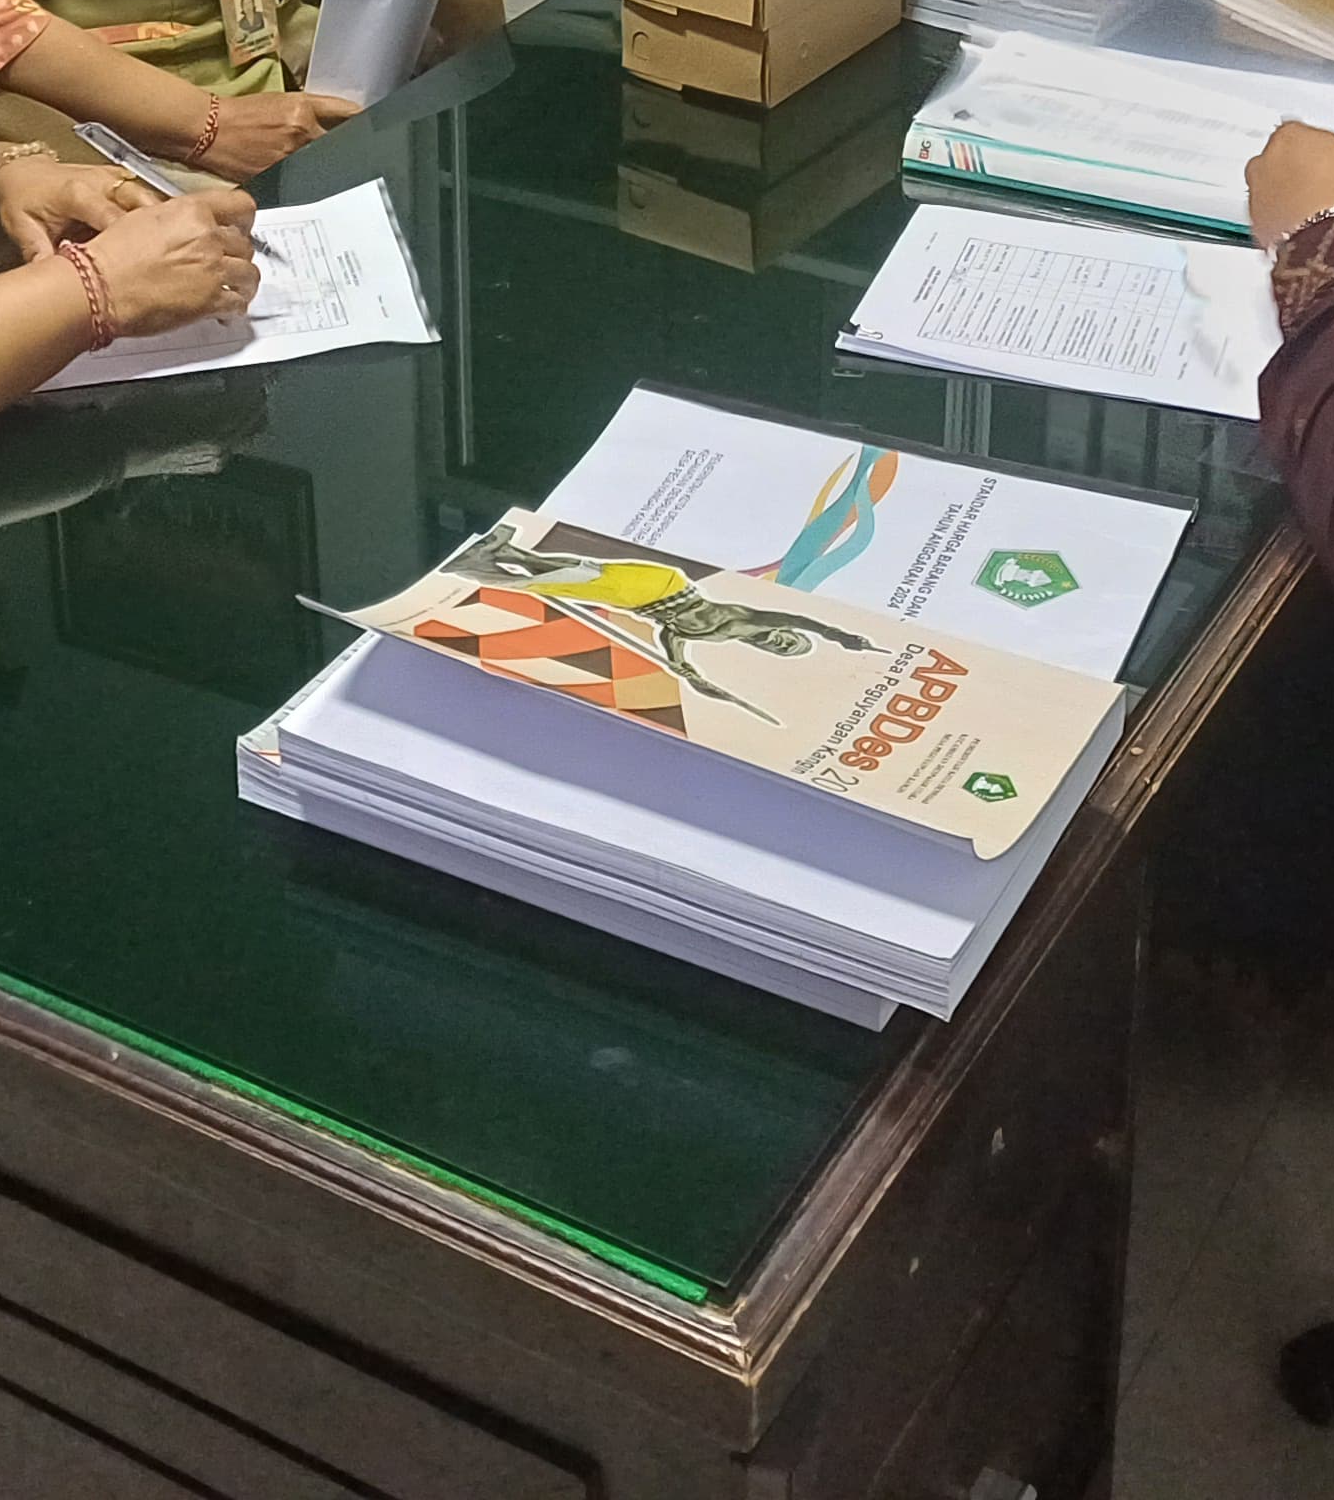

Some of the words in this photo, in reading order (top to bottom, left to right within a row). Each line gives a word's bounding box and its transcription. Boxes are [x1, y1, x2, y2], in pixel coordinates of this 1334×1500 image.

[967, 477, 997, 525] STANDAR
[937, 503, 963, 534] TAHUN
[946, 521, 972, 554] HARGA
[903, 532, 943, 588] ANGGARAN
[923, 554, 953, 595] BARANG
[887, 588, 911, 609] 2024
[909, 595, 928, 619] DAN
[889, 643, 925, 674] Desa
[827, 675, 900, 746] Peguyangan
[838, 649, 969, 772] APBDes
[791, 742, 839, 775] Kangin
